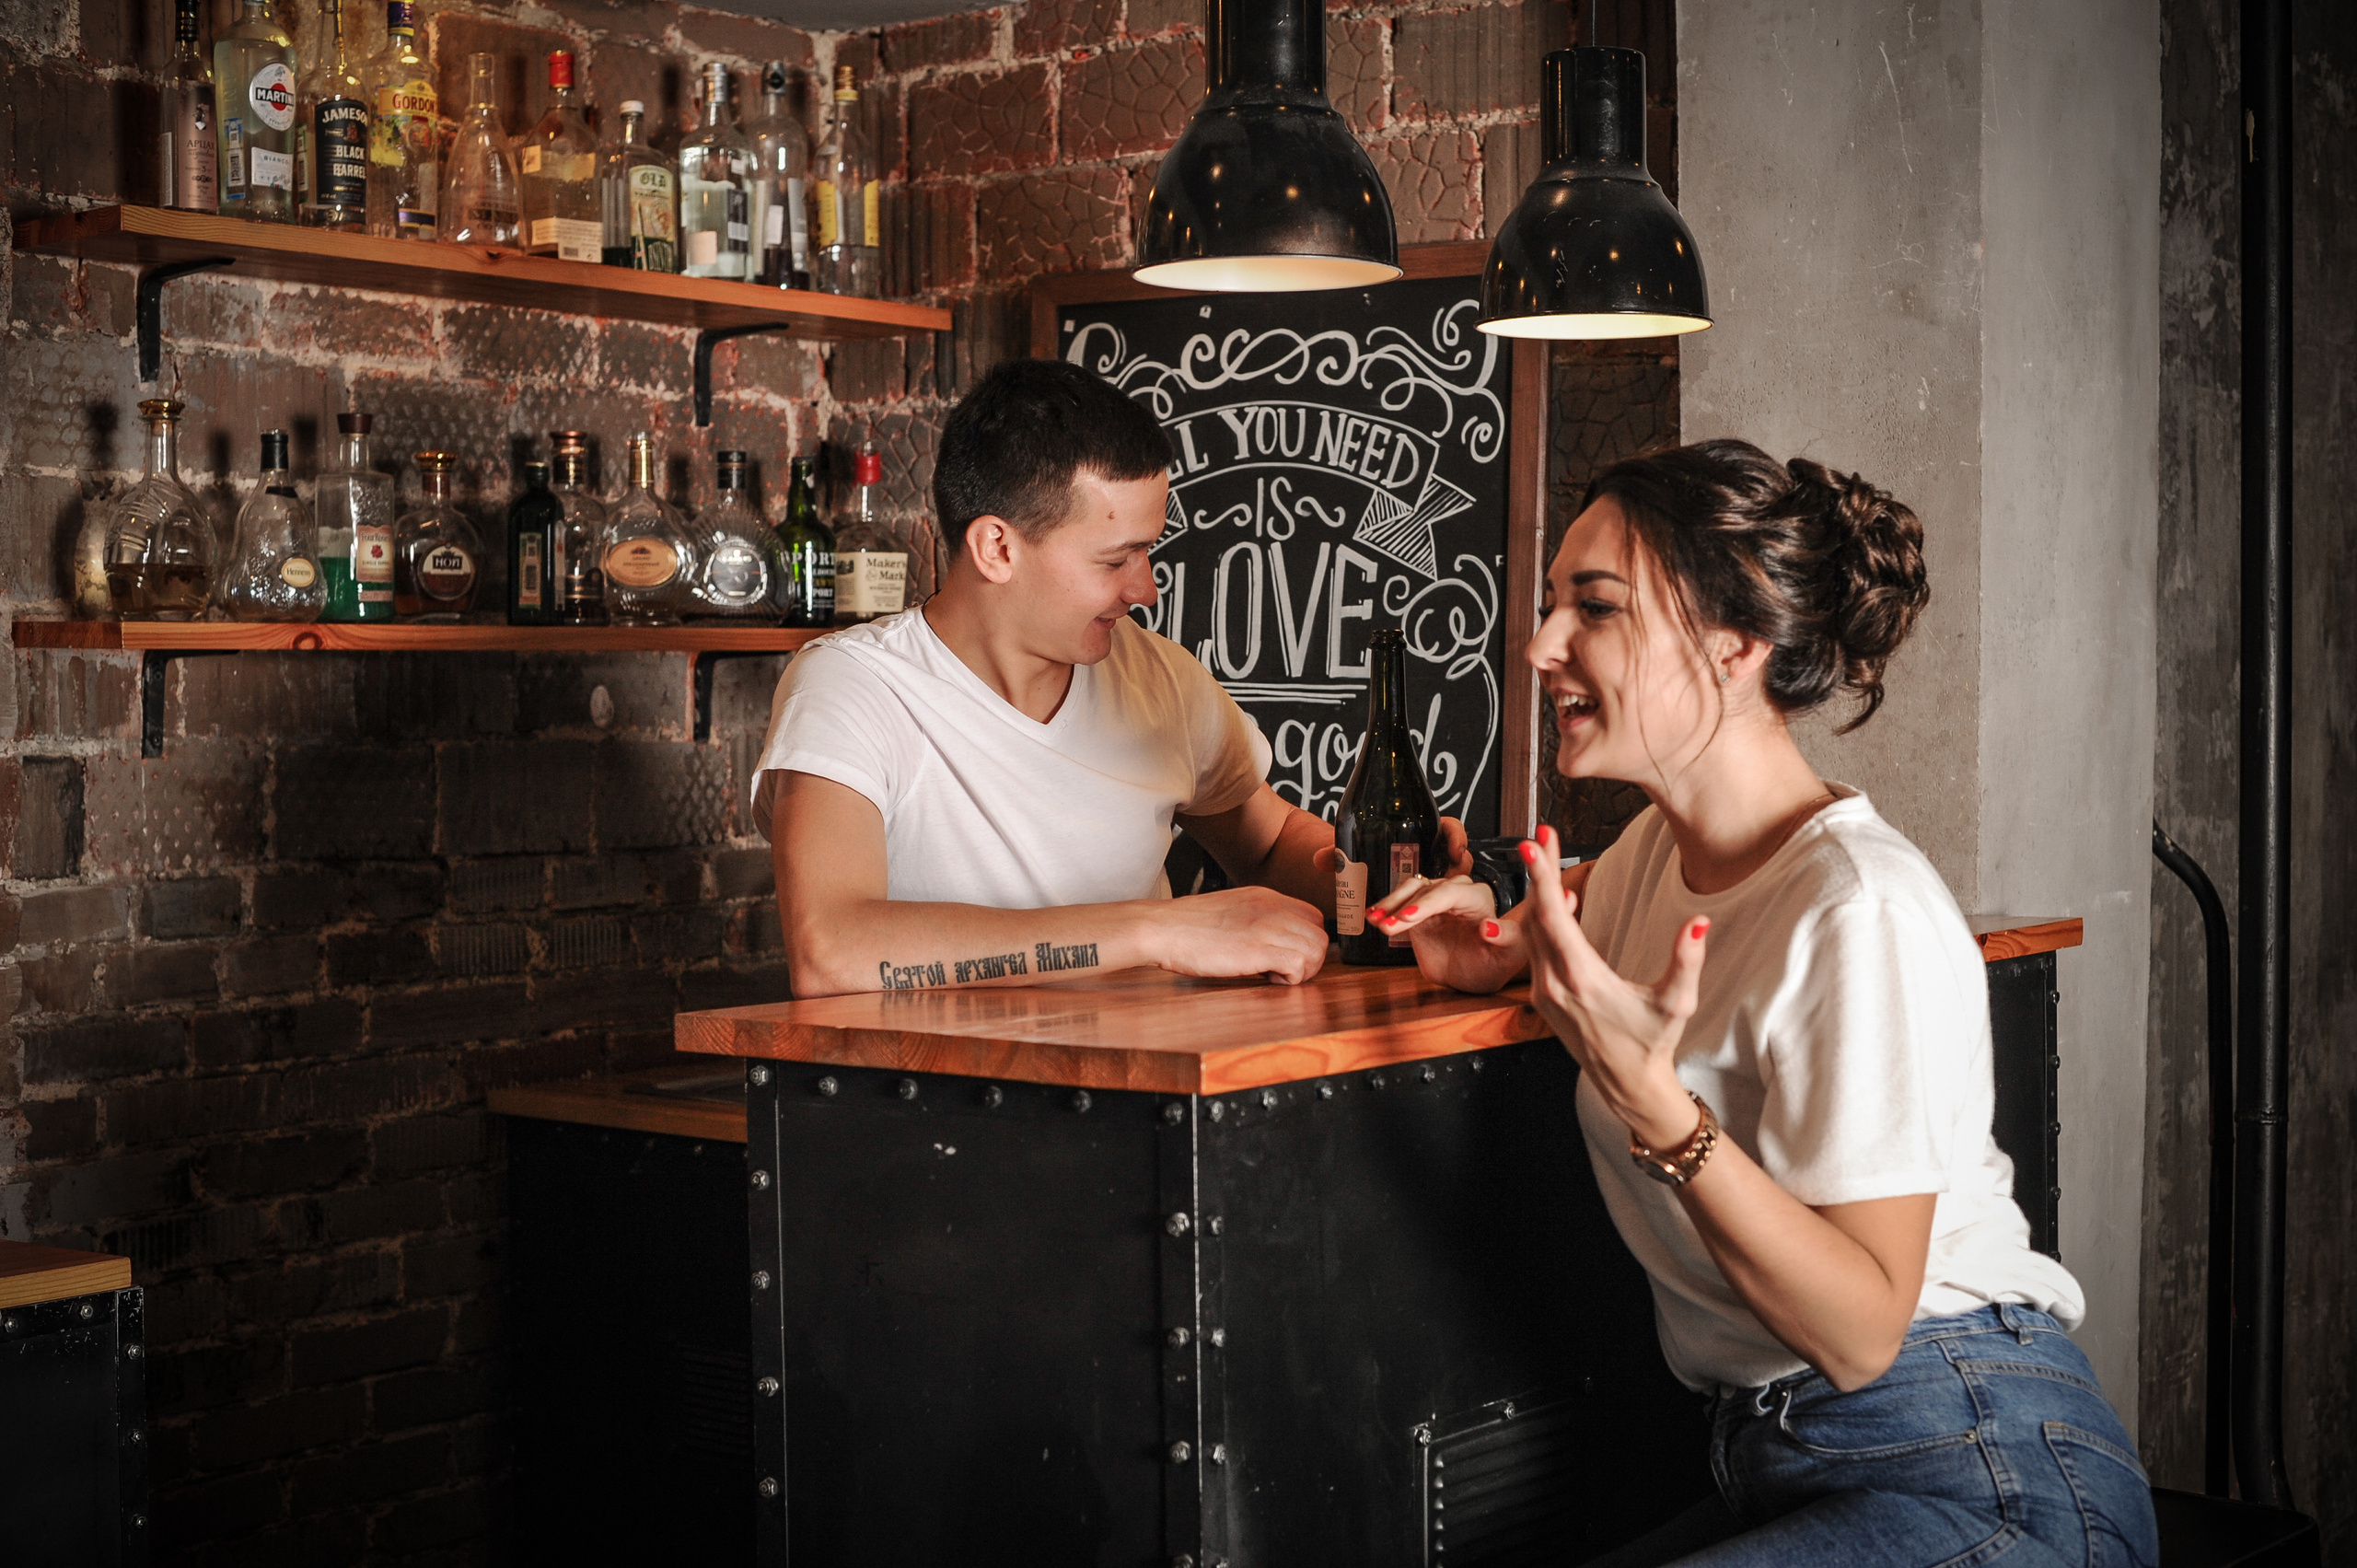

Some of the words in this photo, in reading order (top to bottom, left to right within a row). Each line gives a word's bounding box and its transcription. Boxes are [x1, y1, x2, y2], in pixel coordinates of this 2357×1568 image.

[333, 163, 366, 179] BARREL
[336, 145, 365, 159] BLACK
[1217, 406, 1306, 459] YOU
[1309, 411, 1419, 488] NEED
[1256, 477, 1295, 540] IS
[1167, 541, 1378, 679] LOVE
[1274, 692, 1458, 812] god
